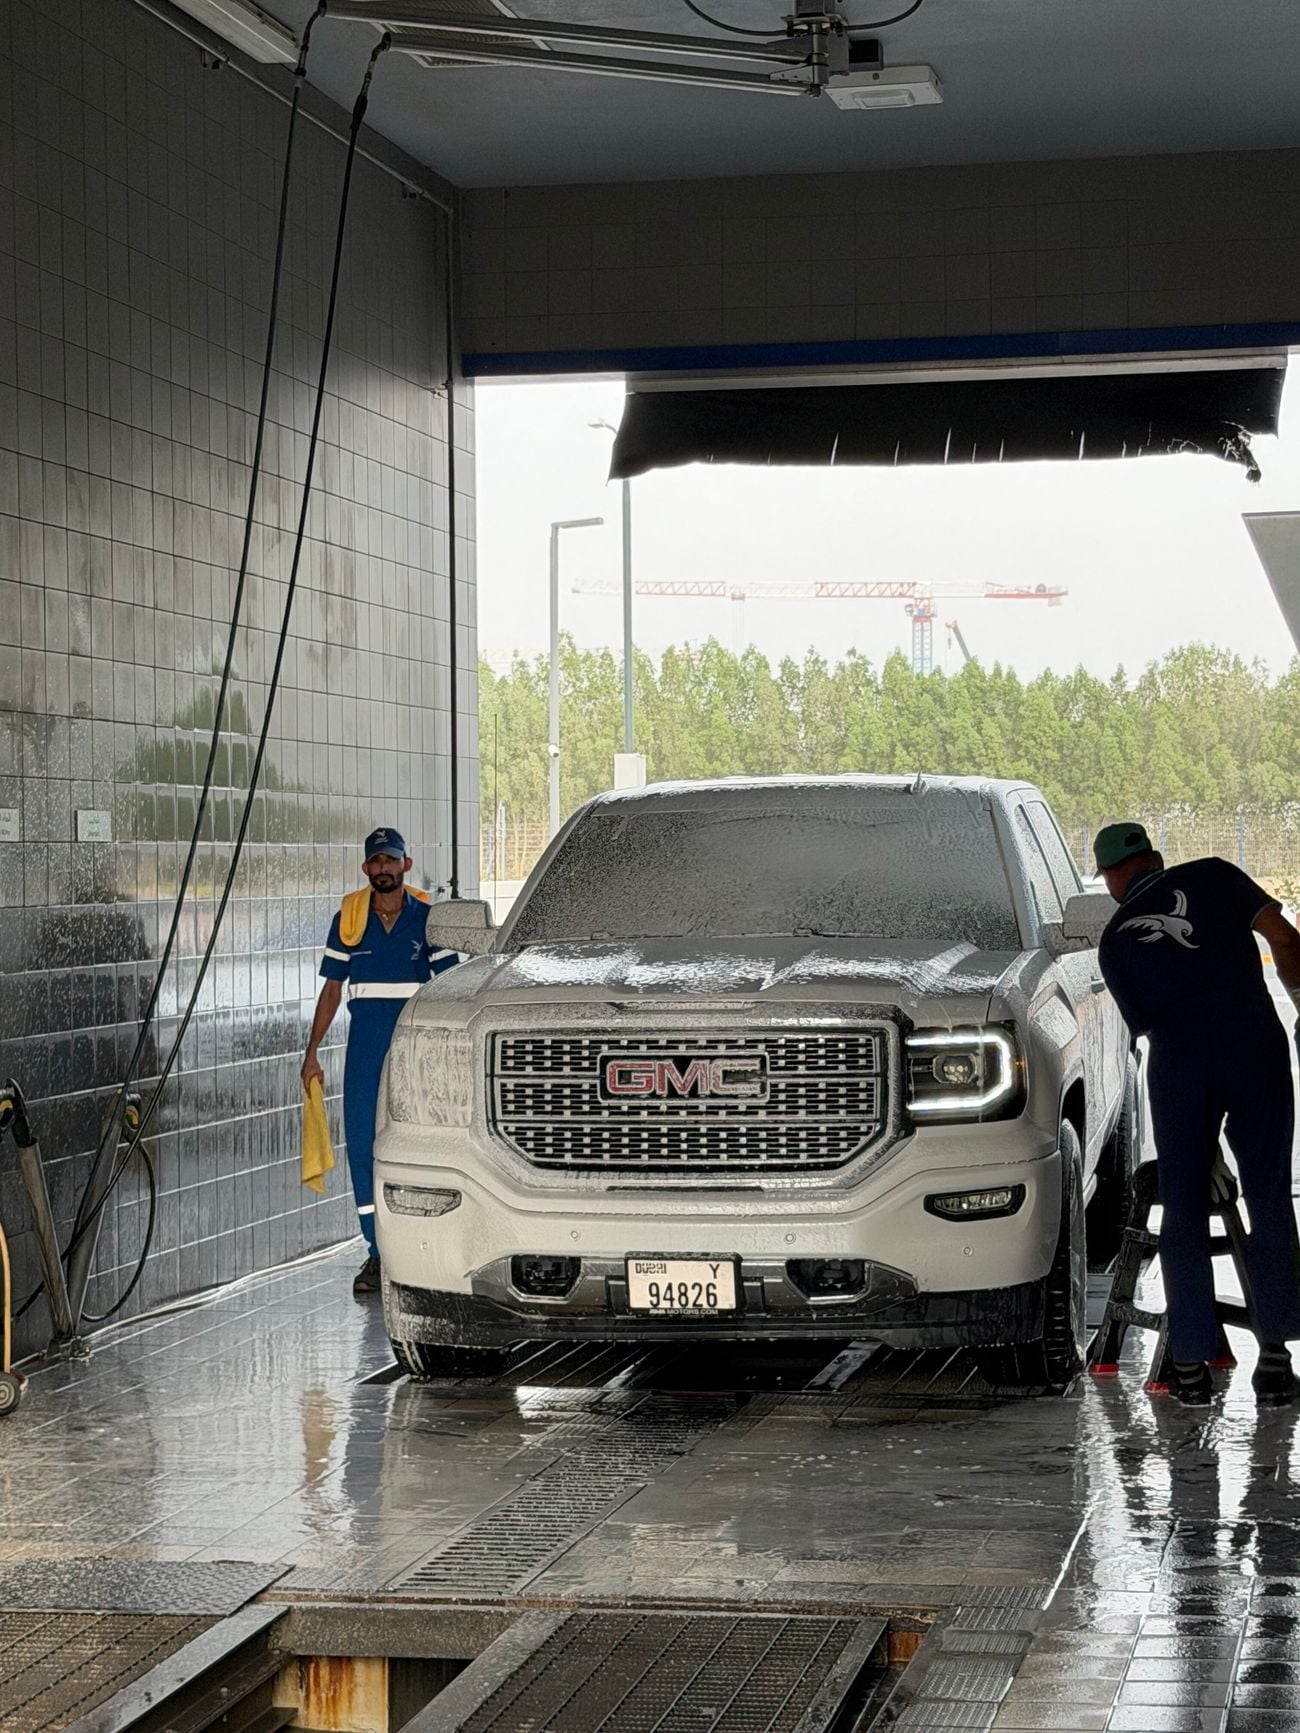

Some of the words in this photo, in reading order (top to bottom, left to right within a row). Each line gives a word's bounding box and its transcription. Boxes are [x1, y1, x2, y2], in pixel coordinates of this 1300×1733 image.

[607, 1058, 760, 1095] GMC
[709, 1264, 720, 1279] Y
[648, 1282, 718, 1308] 94826
